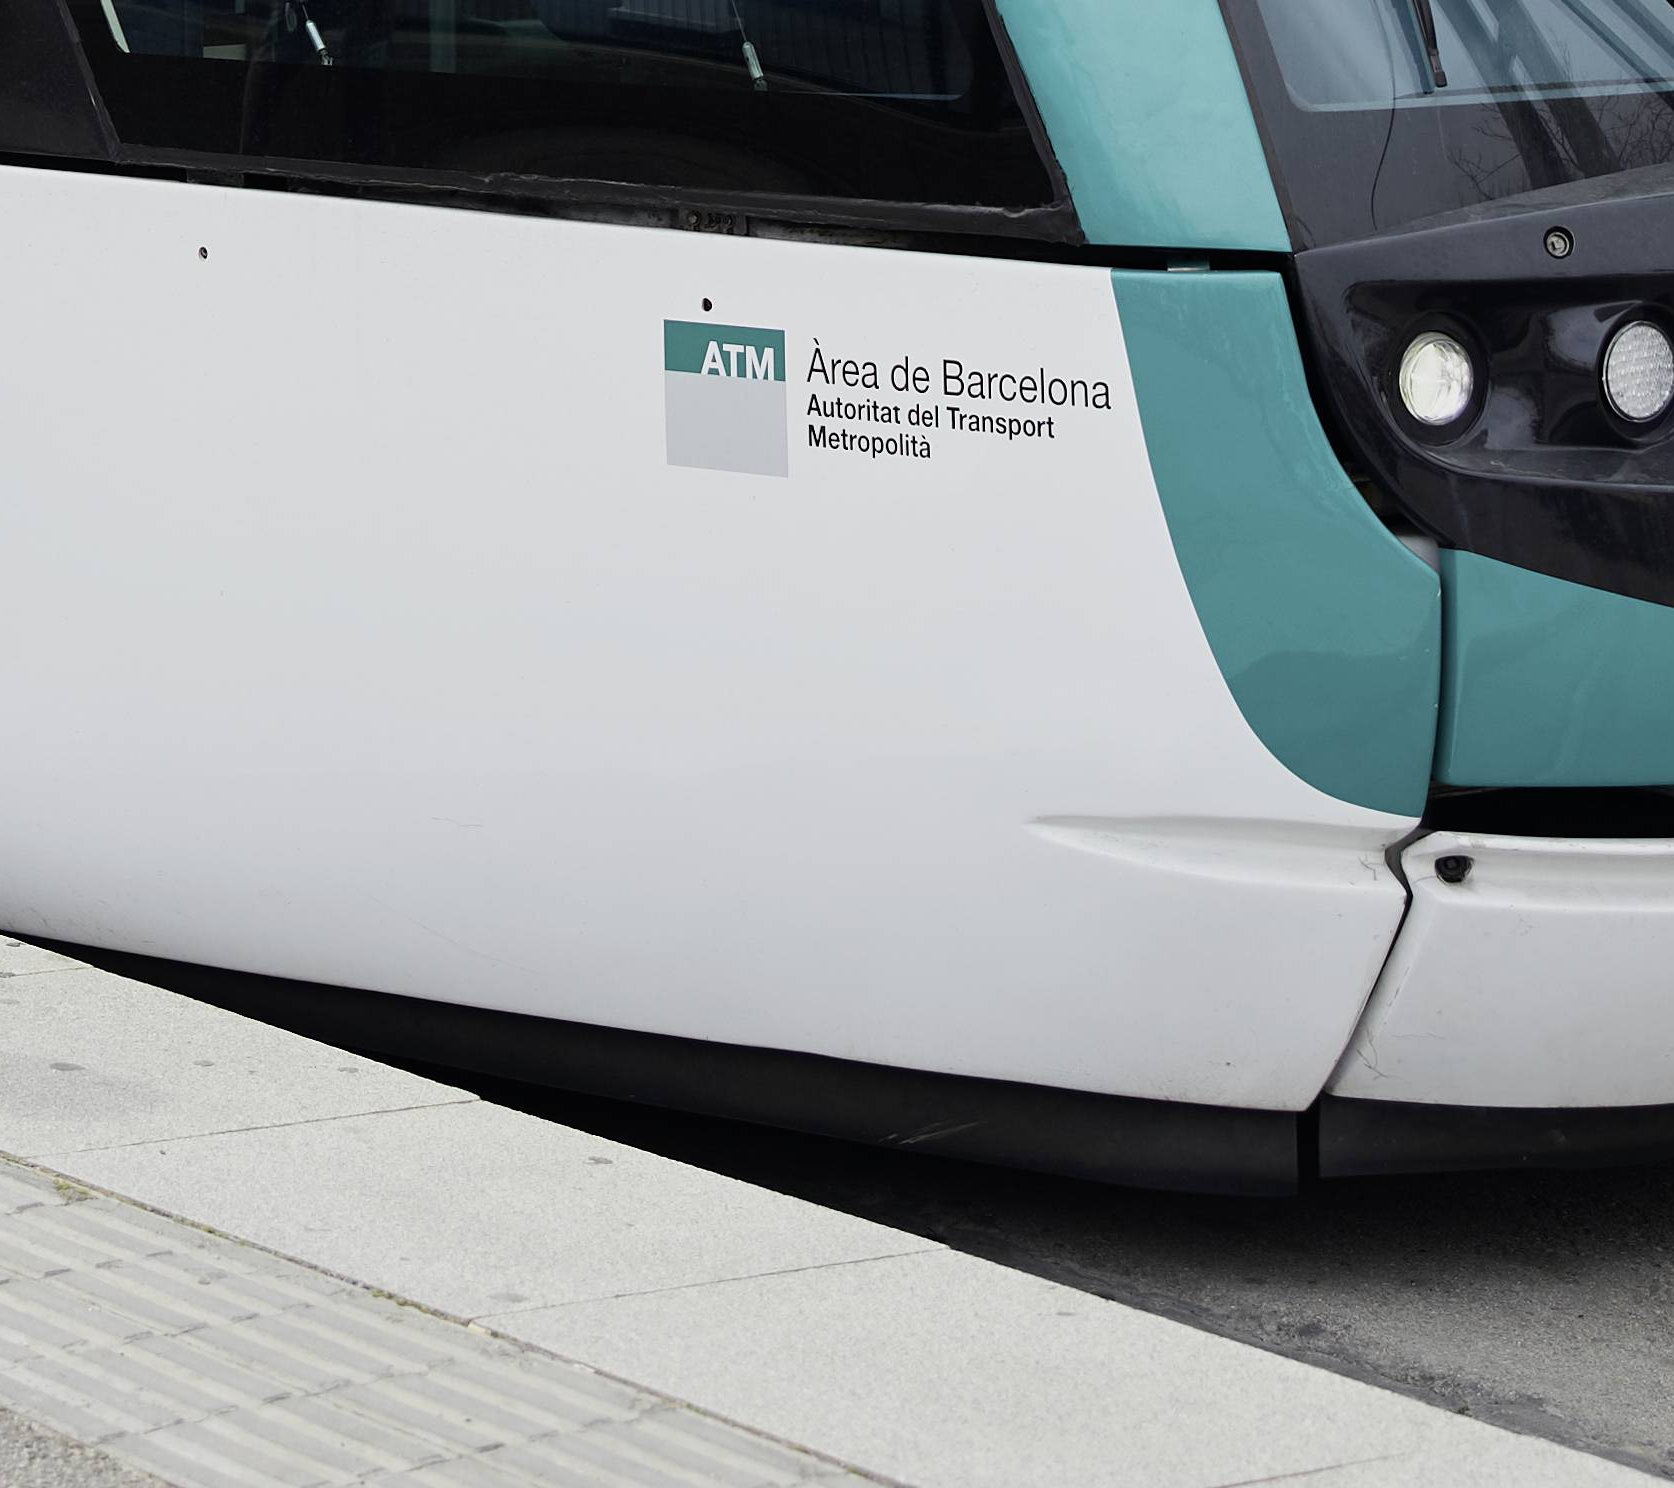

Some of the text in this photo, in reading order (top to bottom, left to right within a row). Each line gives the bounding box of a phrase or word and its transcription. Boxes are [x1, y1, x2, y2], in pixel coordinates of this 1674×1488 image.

[700, 340, 776, 381] ATM
[806, 337, 1112, 411] Àrea de Barcelona
[806, 393, 1055, 440] Autoritat del Transport
[807, 424, 932, 459] Metropolità
